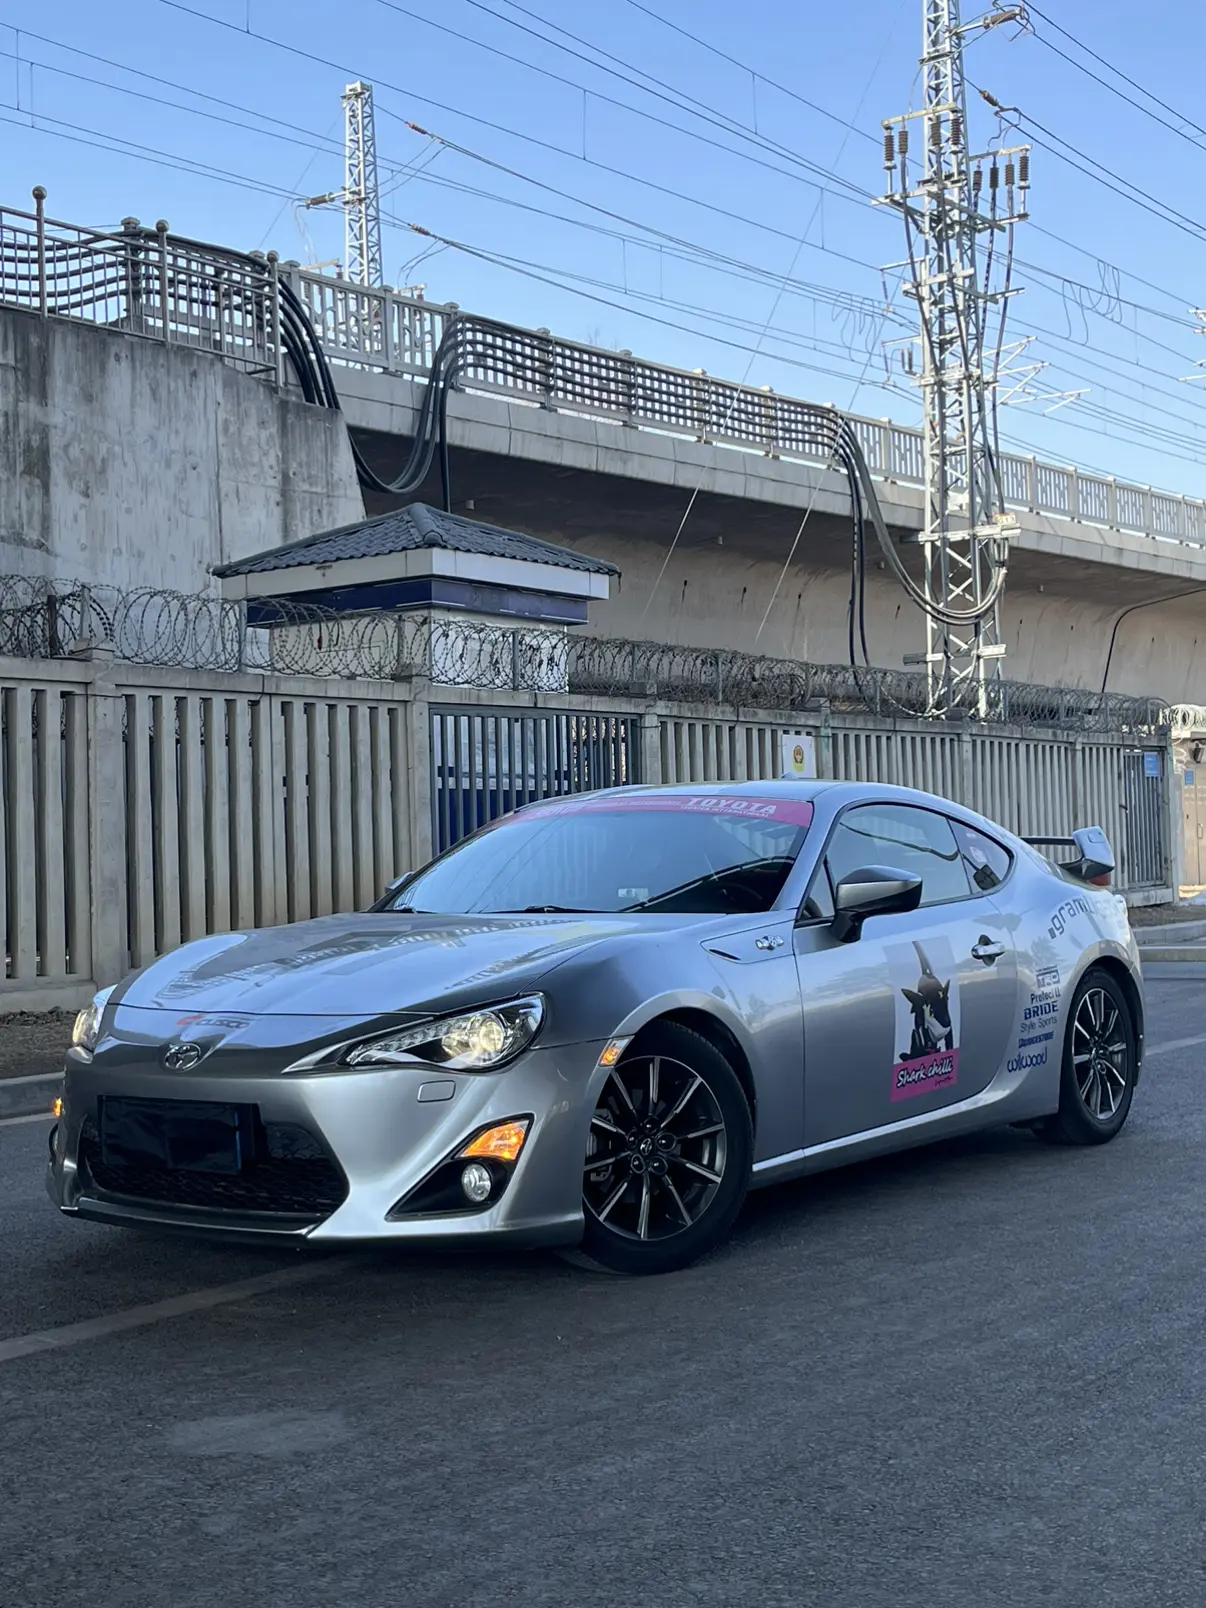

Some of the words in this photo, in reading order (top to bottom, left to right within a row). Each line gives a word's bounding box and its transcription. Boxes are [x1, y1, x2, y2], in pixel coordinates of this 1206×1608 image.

[686, 797, 777, 814] TOYOTA
[1024, 1001, 1059, 1020] BRIDE
[1020, 1022, 1036, 1034] Style
[1039, 1016, 1058, 1029] Sports
[896, 1063, 927, 1088] Shark
